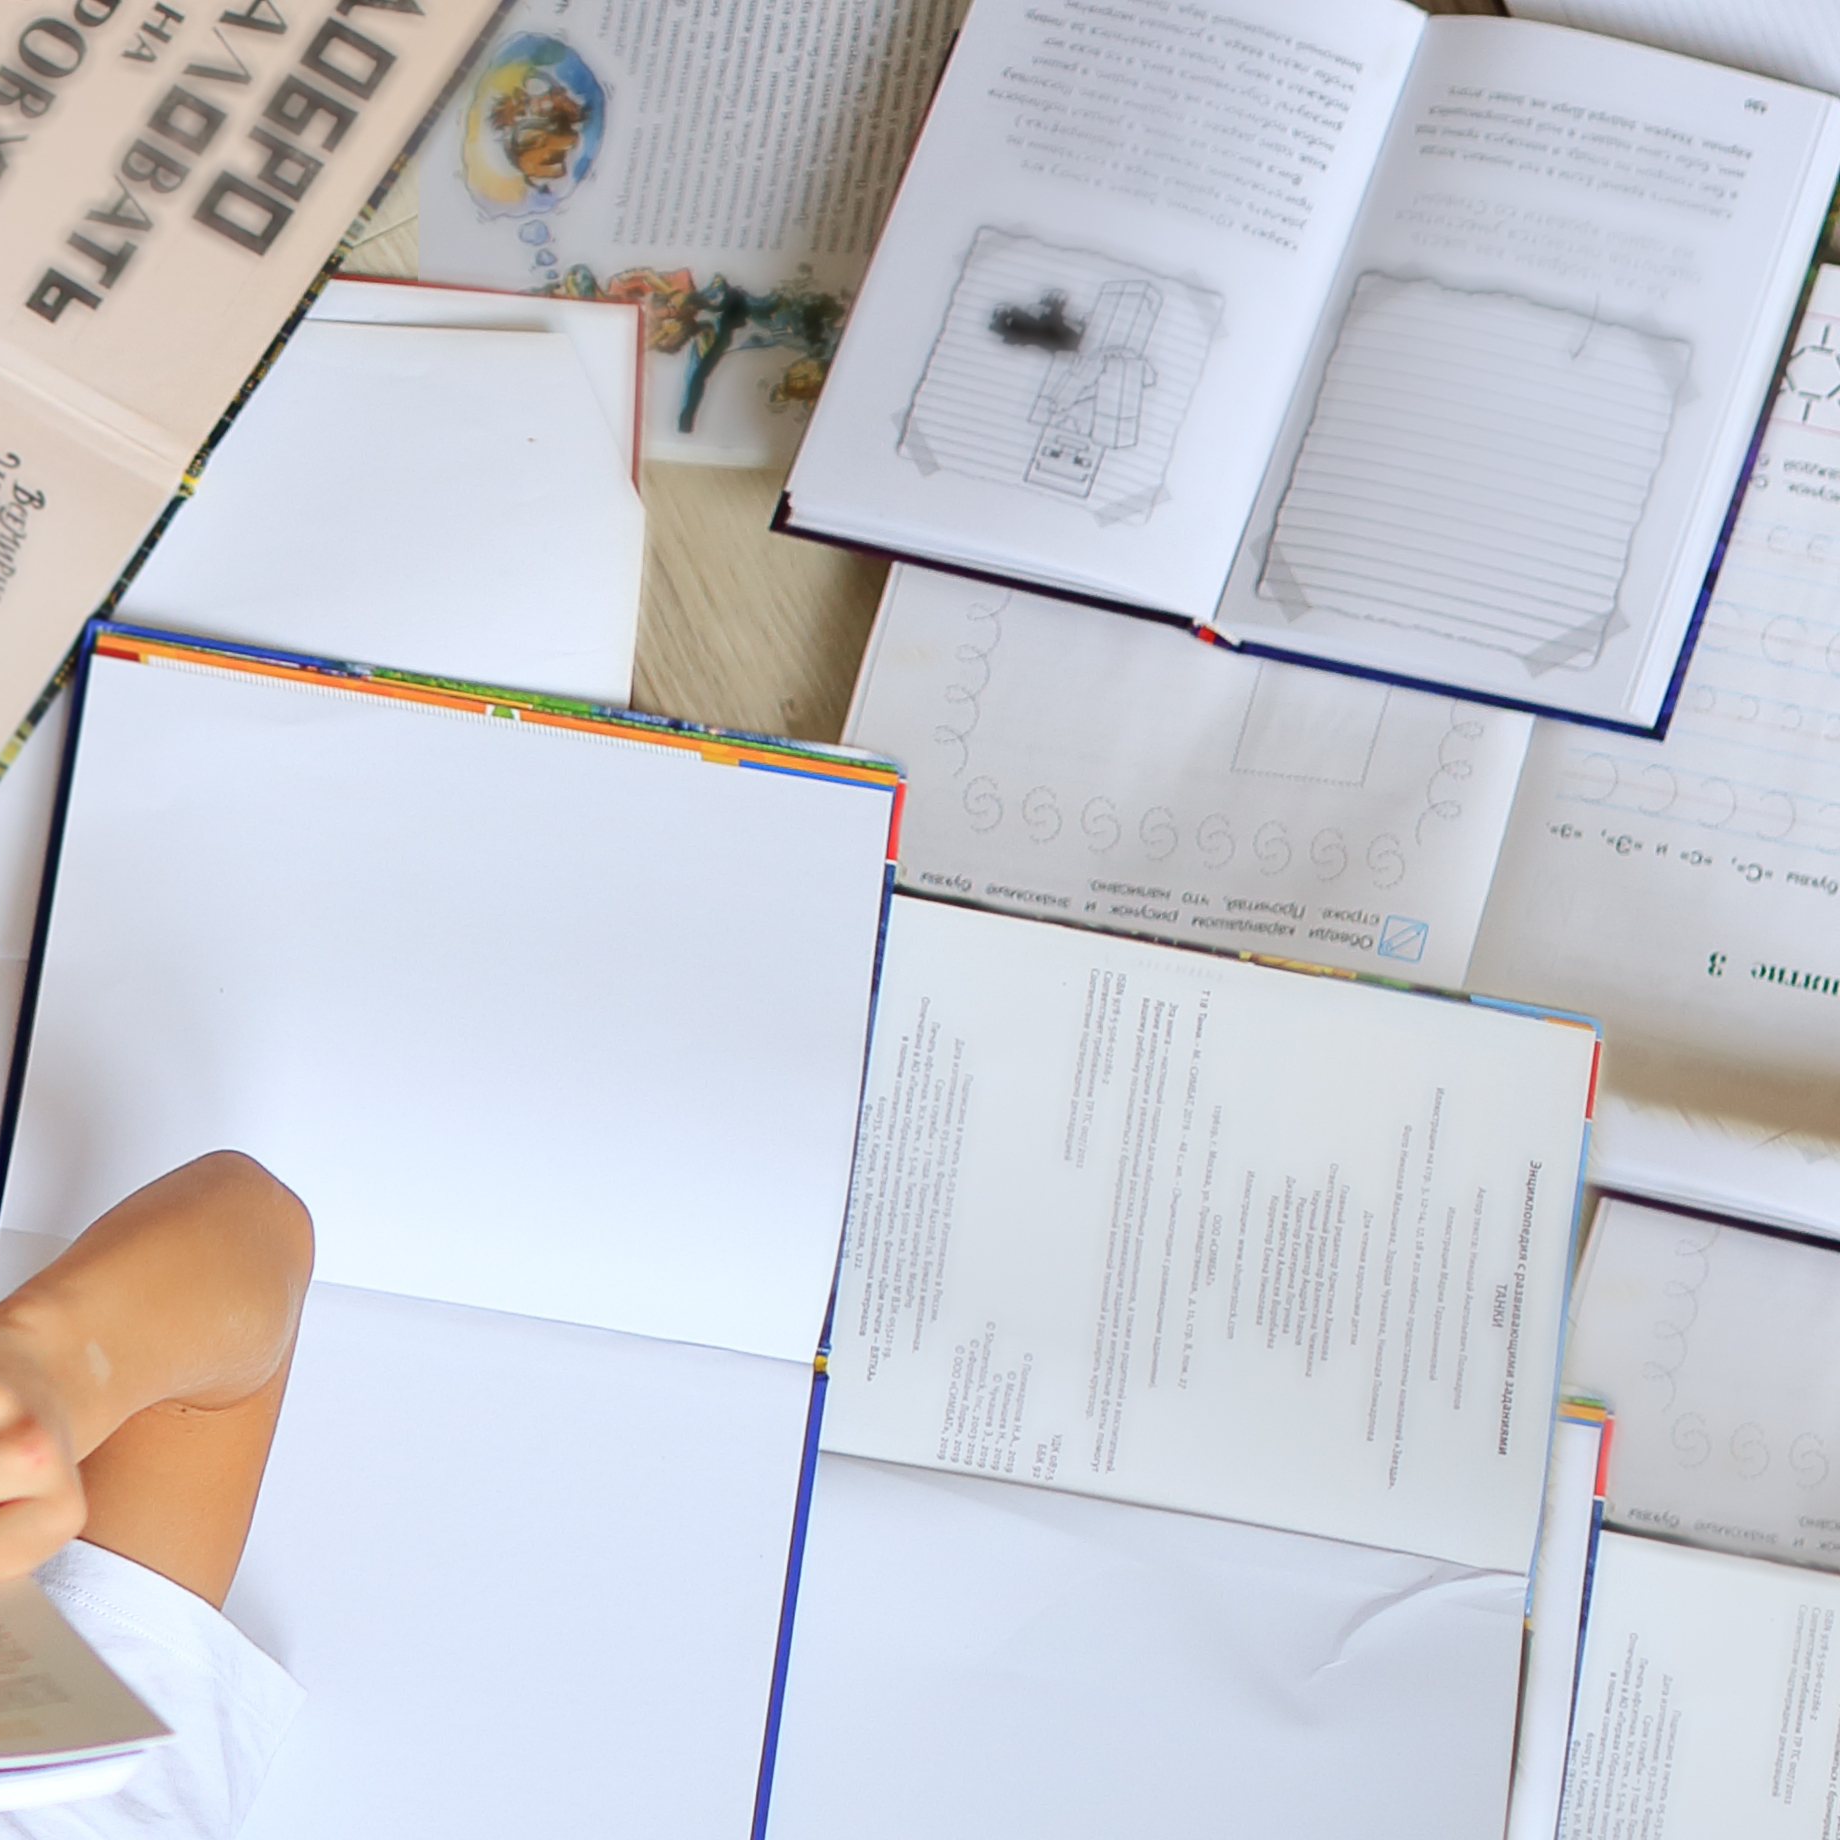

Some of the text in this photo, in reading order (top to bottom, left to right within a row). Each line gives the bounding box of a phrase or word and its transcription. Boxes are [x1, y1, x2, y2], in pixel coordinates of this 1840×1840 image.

[120, 2, 186, 66] НА
[1707, 951, 1726, 978] 3
[1517, 1159, 1542, 1261] Энциклопедия
[1491, 1283, 1507, 1328] ТАНКИ
[1501, 1272, 1527, 1378] развивающими
[1493, 1380, 1517, 1456] заданиями
